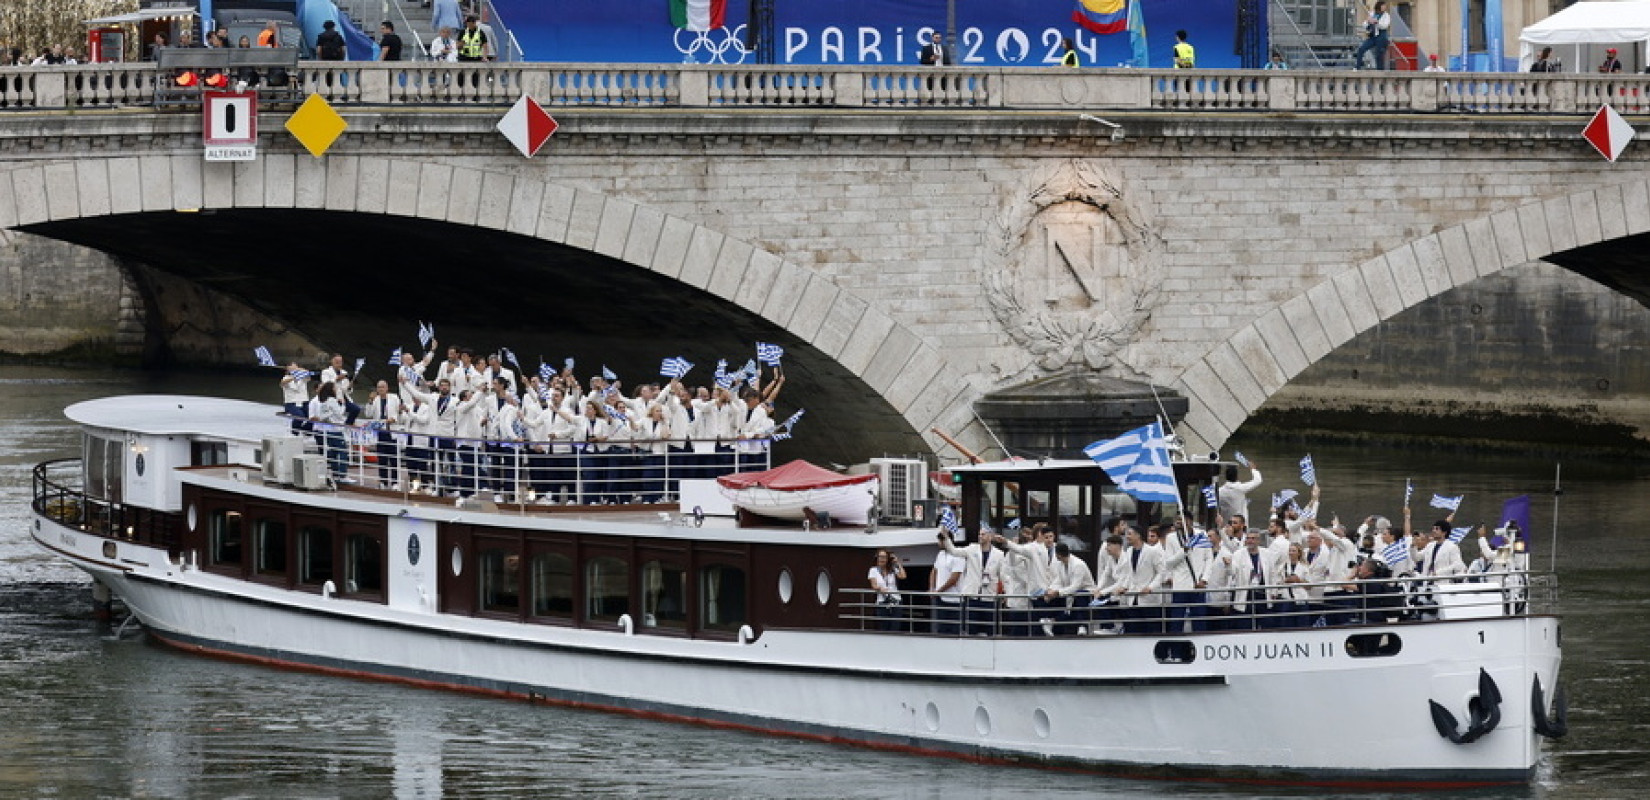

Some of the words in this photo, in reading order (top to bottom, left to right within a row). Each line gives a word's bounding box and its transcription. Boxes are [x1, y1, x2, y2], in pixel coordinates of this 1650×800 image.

[963, 27, 1096, 63] 2024
[207, 149, 252, 158] ALTERNAT
[1044, 224, 1101, 302] N
[1477, 630, 1484, 645] 1
[1203, 644, 1247, 660] DON
[1254, 643, 1309, 659] JUAN
[1320, 641, 1333, 657] II
